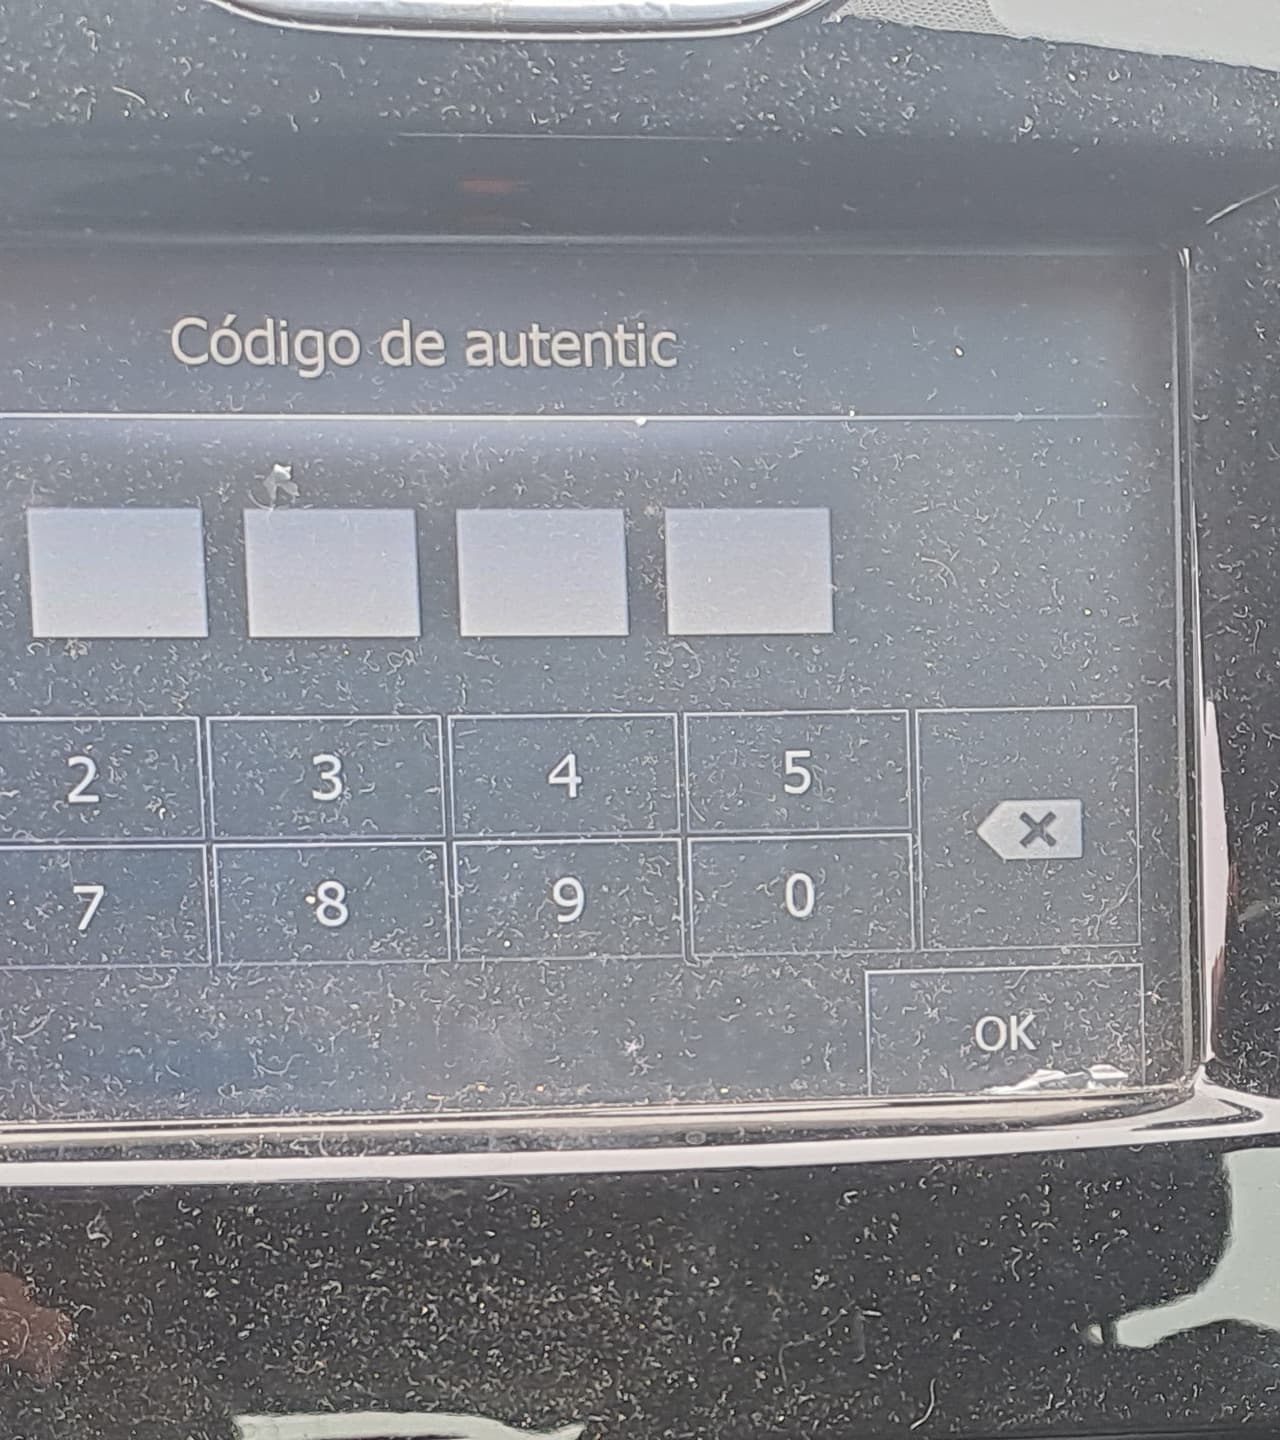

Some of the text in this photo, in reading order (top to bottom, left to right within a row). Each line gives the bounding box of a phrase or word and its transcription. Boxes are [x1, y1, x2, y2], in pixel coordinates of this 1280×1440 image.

[170, 313, 678, 379] Código de autentic
[66, 755, 100, 803] 2
[311, 754, 344, 801] 3
[547, 752, 582, 798] 4
[782, 749, 813, 795] 5
[72, 885, 105, 931] 7
[316, 880, 348, 927] 8
[551, 877, 585, 923] 9
[785, 872, 815, 918] 0
[973, 1013, 1037, 1052] OK
